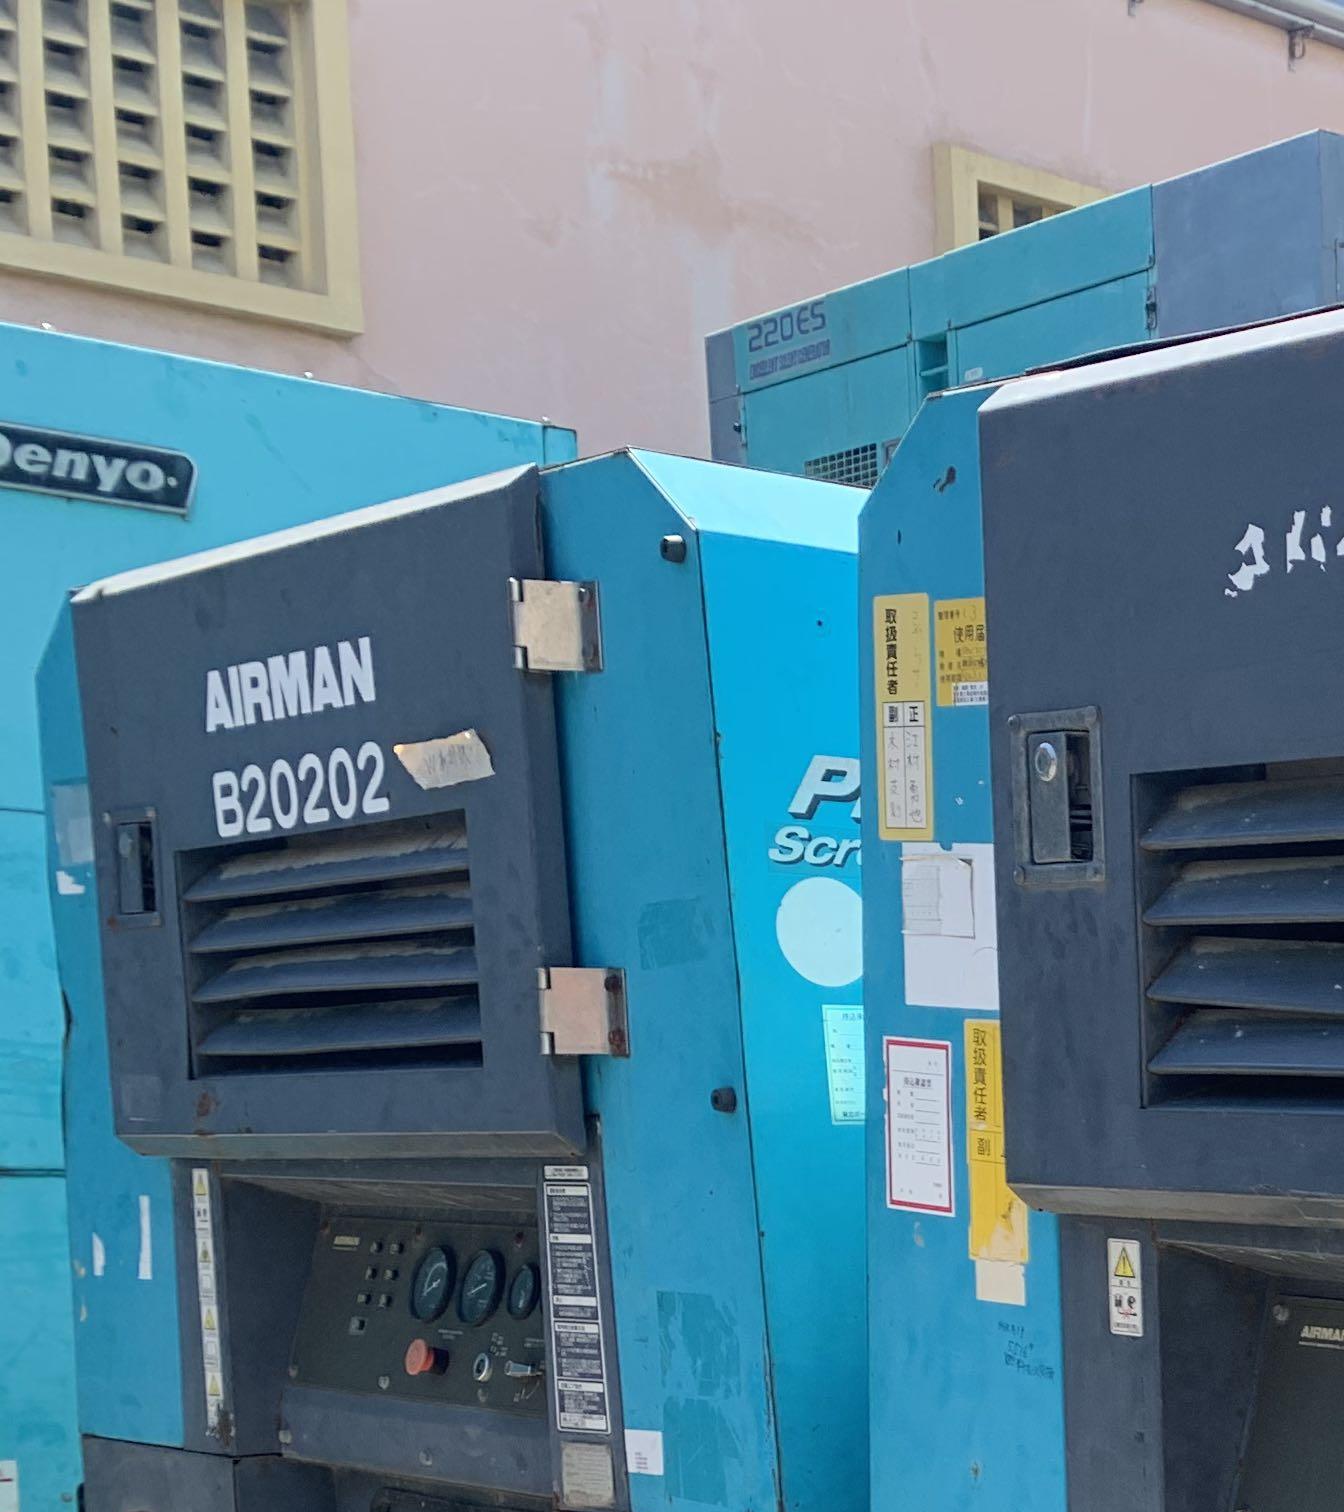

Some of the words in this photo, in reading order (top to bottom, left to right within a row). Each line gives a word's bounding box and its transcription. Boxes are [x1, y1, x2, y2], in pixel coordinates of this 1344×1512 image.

[747, 301, 826, 352] 220ES
[0, 432, 164, 492] enyo
[206, 637, 376, 732] AIRMAN
[885, 608, 898, 695] 取扱責任者
[909, 707, 919, 722] 正
[212, 741, 390, 837] B20202
[768, 825, 862, 867] Scr
[973, 1027, 988, 1121] 取扱責任者
